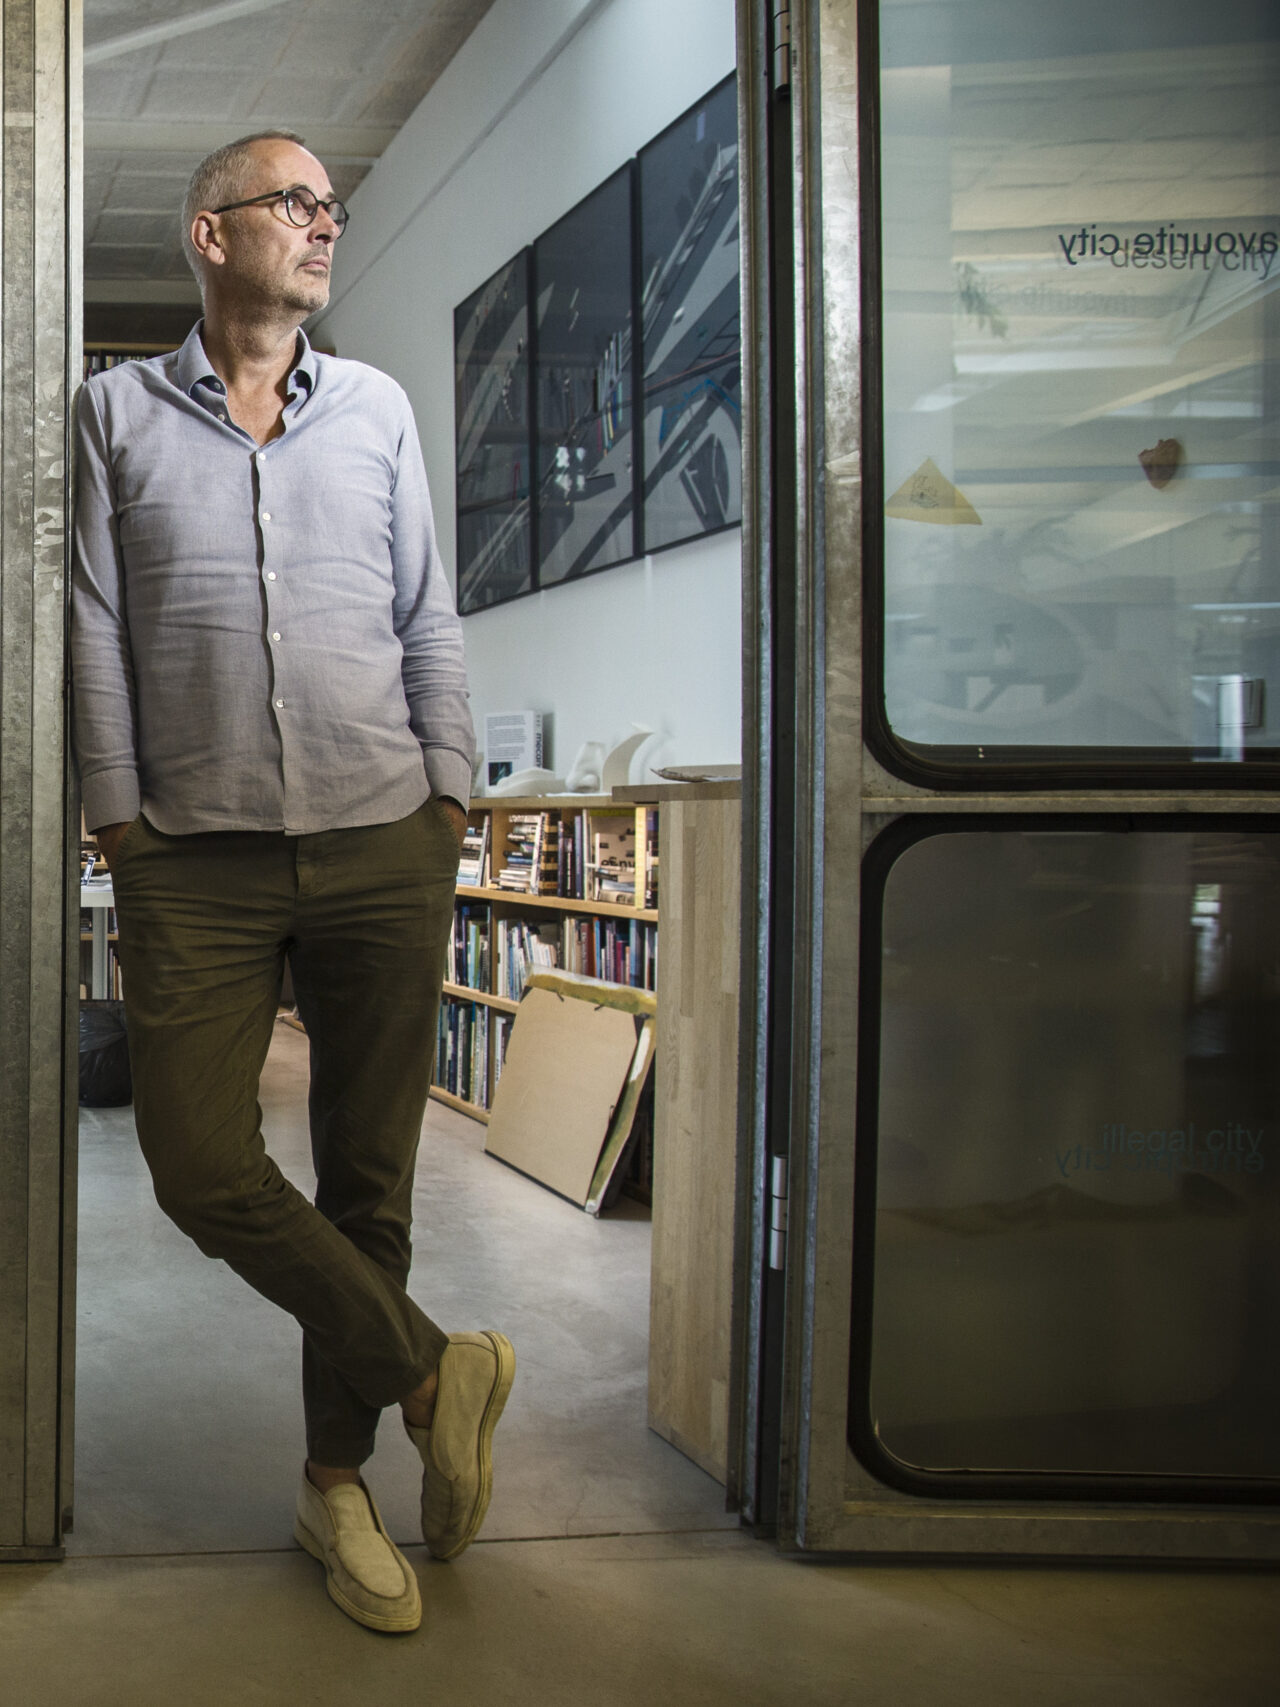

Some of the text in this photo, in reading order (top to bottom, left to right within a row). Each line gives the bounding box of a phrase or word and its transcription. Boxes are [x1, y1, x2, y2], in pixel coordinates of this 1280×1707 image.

[1110, 238, 1275, 280] desert city
[1103, 1121, 1264, 1160] illegal city
